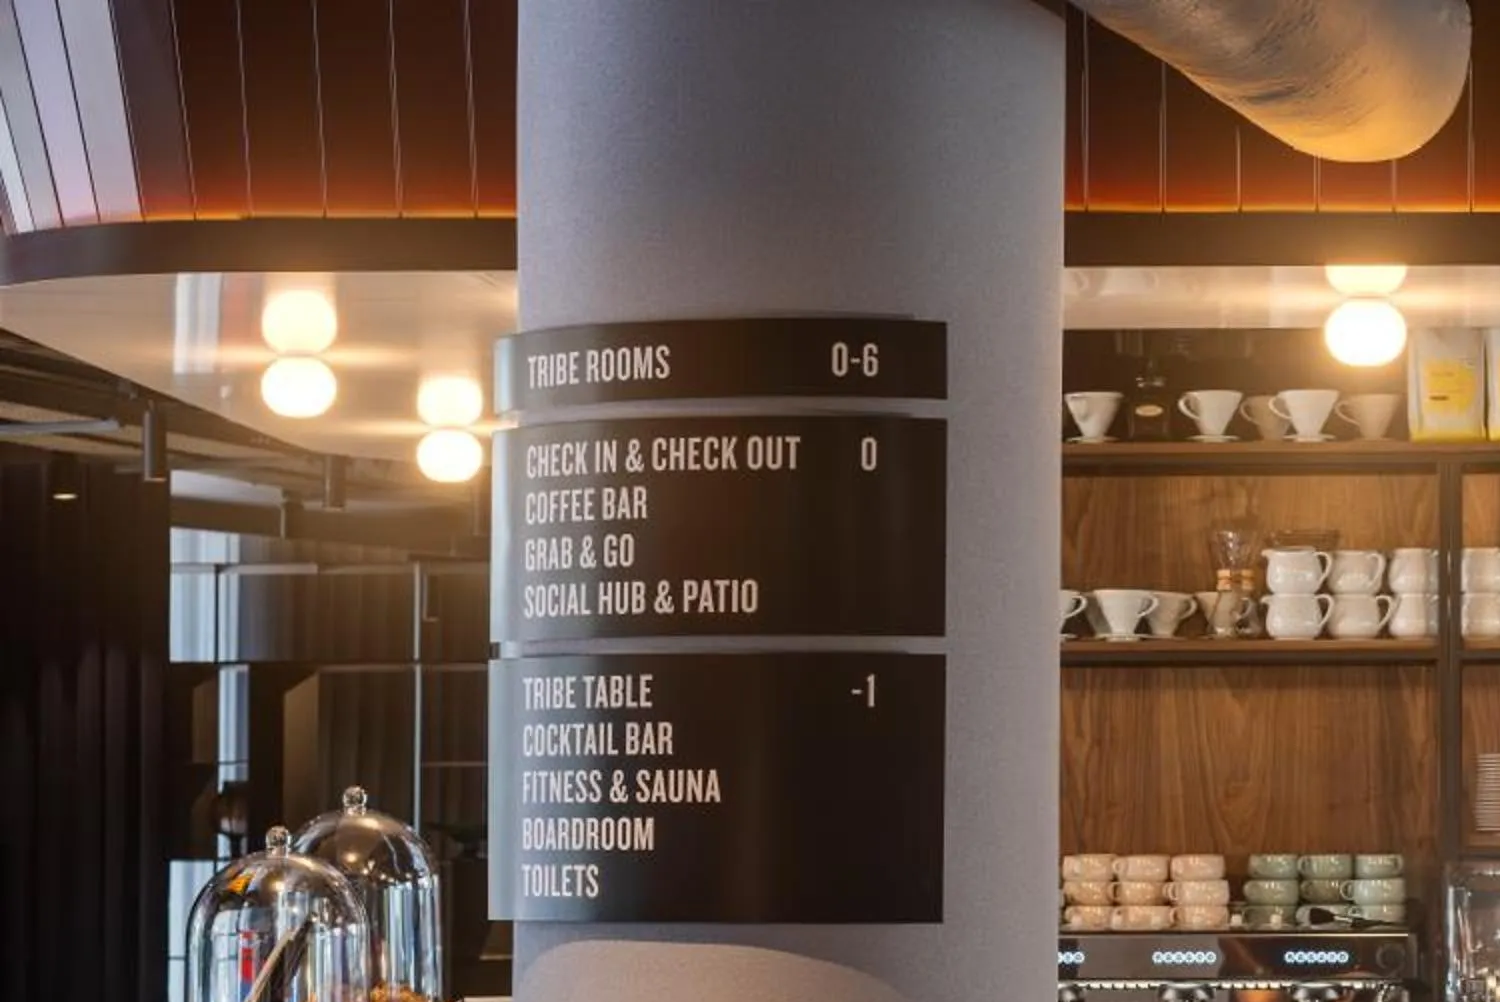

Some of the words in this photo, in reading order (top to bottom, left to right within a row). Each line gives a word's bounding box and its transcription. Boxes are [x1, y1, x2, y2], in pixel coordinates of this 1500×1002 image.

[528, 352, 579, 388] TRIBE
[587, 345, 670, 382] ROOMS
[832, 342, 878, 376] 0-6
[527, 442, 587, 478] CHECK
[595, 440, 617, 473] IN
[625, 439, 644, 472] &
[652, 437, 737, 471] CHECK
[747, 436, 800, 470] OUT
[526, 488, 595, 524] COFFEE
[603, 486, 647, 520] BAR
[526, 536, 572, 571] GRAB
[580, 535, 596, 568] &
[604, 534, 634, 567] GO
[524, 583, 591, 618] SOCIAL
[599, 581, 645, 614] HUB
[654, 580, 674, 613] &
[683, 580, 758, 612] PATIO
[523, 676, 576, 709] TRIBE
[583, 674, 652, 708] TABLE
[852, 674, 874, 707] -1
[524, 722, 619, 756] COCKTAIL
[626, 722, 672, 755] BAR
[523, 770, 602, 803] FITNESS
[610, 770, 628, 803] &
[636, 769, 720, 802] SAUNA
[524, 817, 654, 850] BOARDROOM
[522, 864, 599, 898] TOILETS
